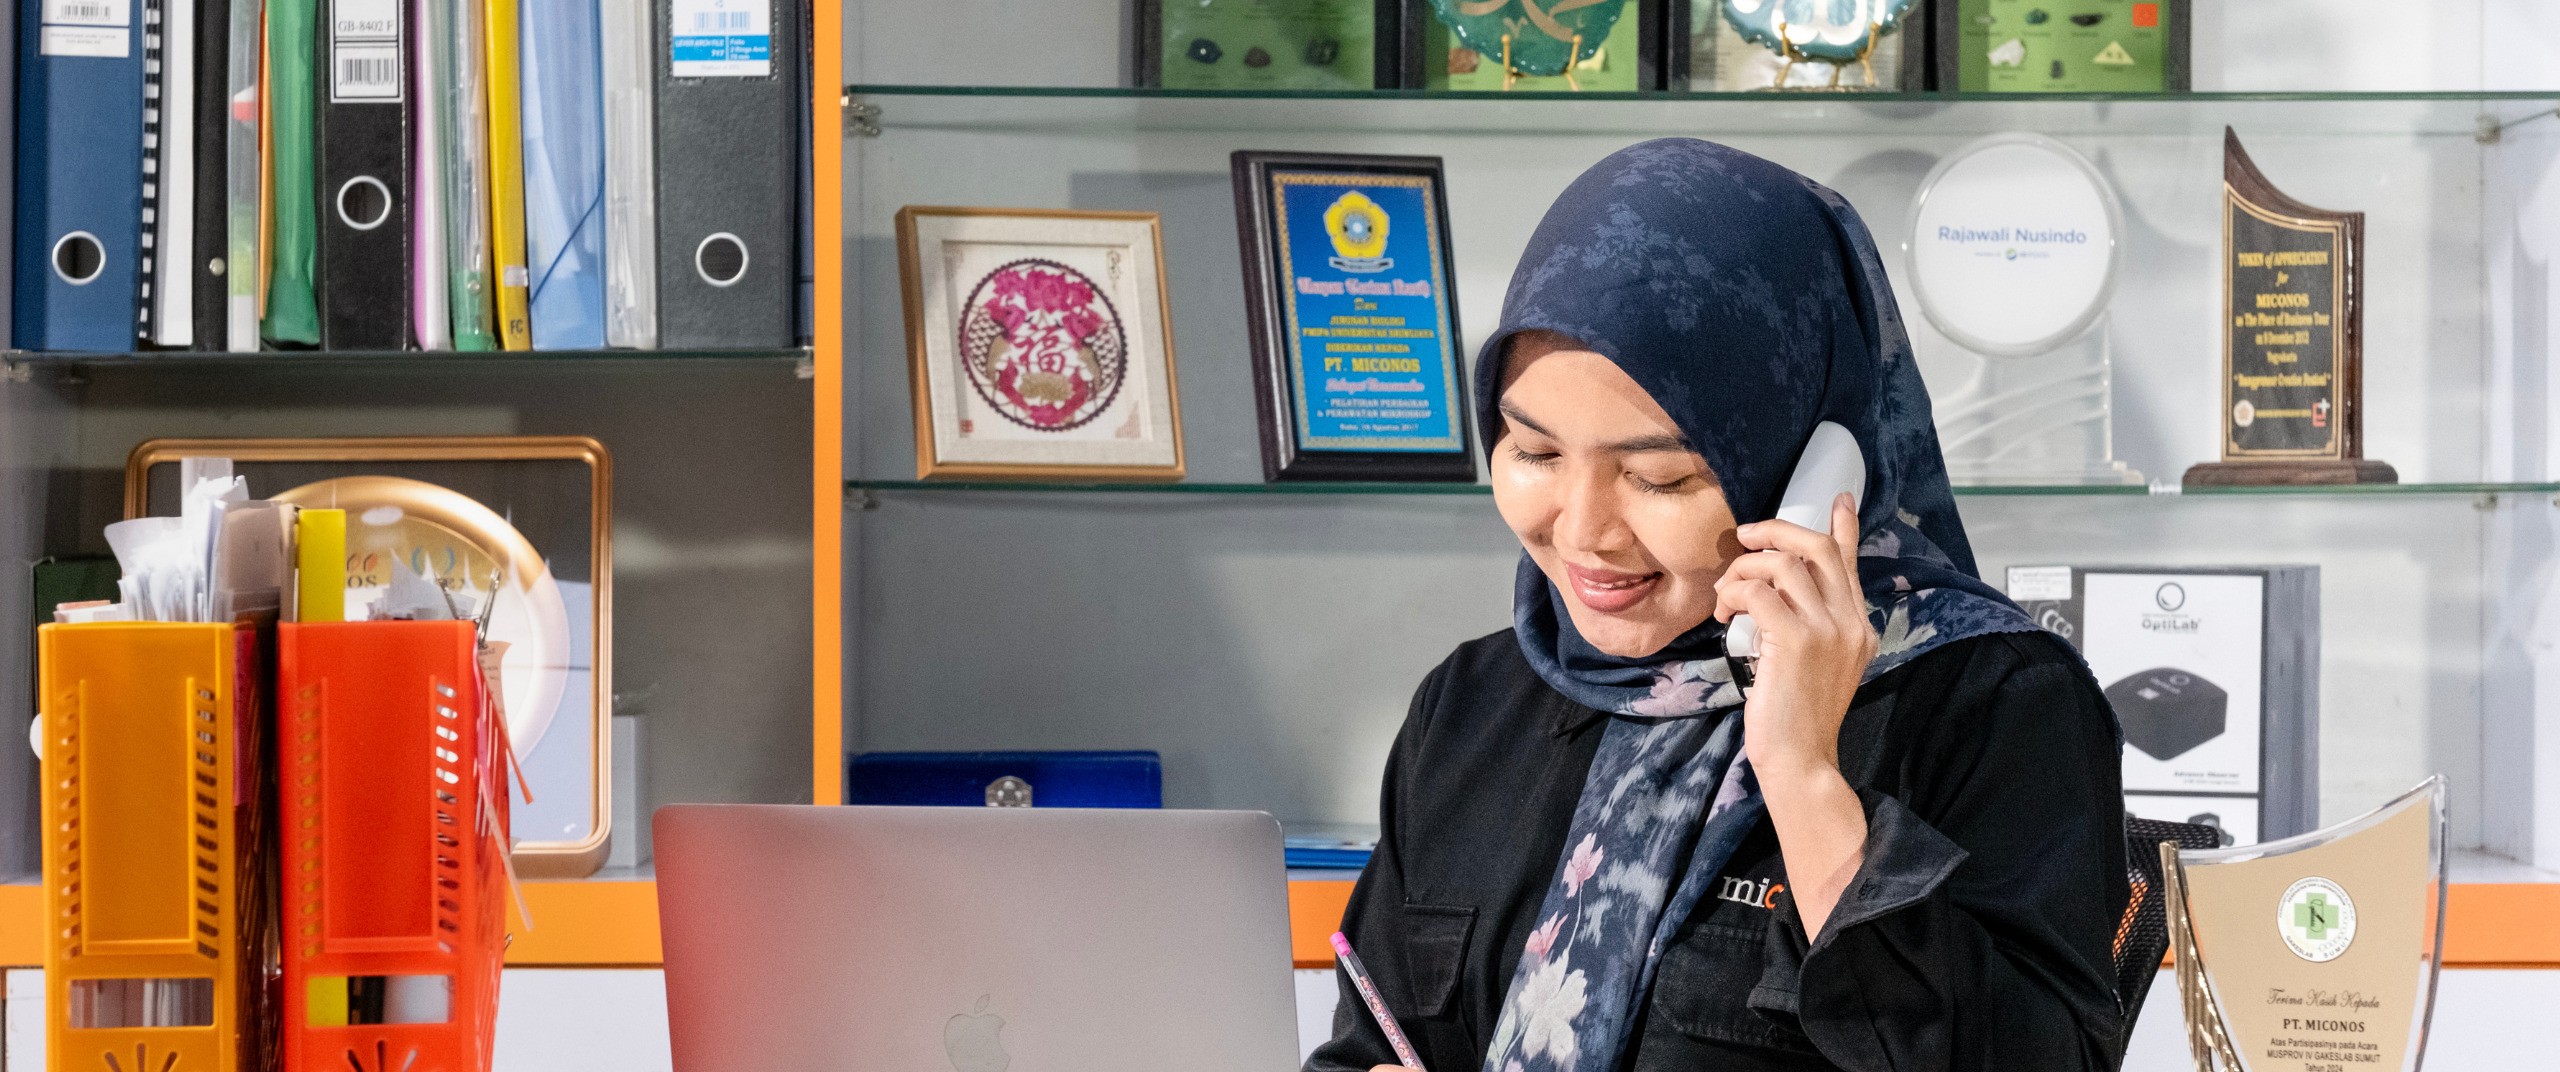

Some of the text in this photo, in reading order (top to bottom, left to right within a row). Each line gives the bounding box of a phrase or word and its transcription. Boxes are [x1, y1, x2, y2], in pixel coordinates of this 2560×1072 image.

[338, 20, 395, 33] GB-8402 F
[1938, 225, 2087, 245] Rajawali Nusindo
[2238, 251, 2328, 269] TOKEN of APPRECIATION
[2275, 270, 2289, 287] for
[2256, 293, 2309, 308] MICONOS
[510, 318, 524, 335] FC
[1014, 322, 1066, 375] 福
[1324, 357, 1421, 373] PT. MICONOS
[2141, 618, 2199, 632] OptiLab
[1717, 876, 1785, 910] mic
[2267, 987, 2381, 1014] Terima Kasih Kepada
[2282, 1018, 2366, 1034] PT. MICONOS
[2270, 1037, 2287, 1047] Atas
[2338, 1041, 2357, 1051] pada
[2357, 1040, 2379, 1051] Acara
[2266, 1048, 2382, 1064] MUSPROV IV GAKESLAB SUMUT
[2304, 1062, 2344, 1072] Tahun 2024
